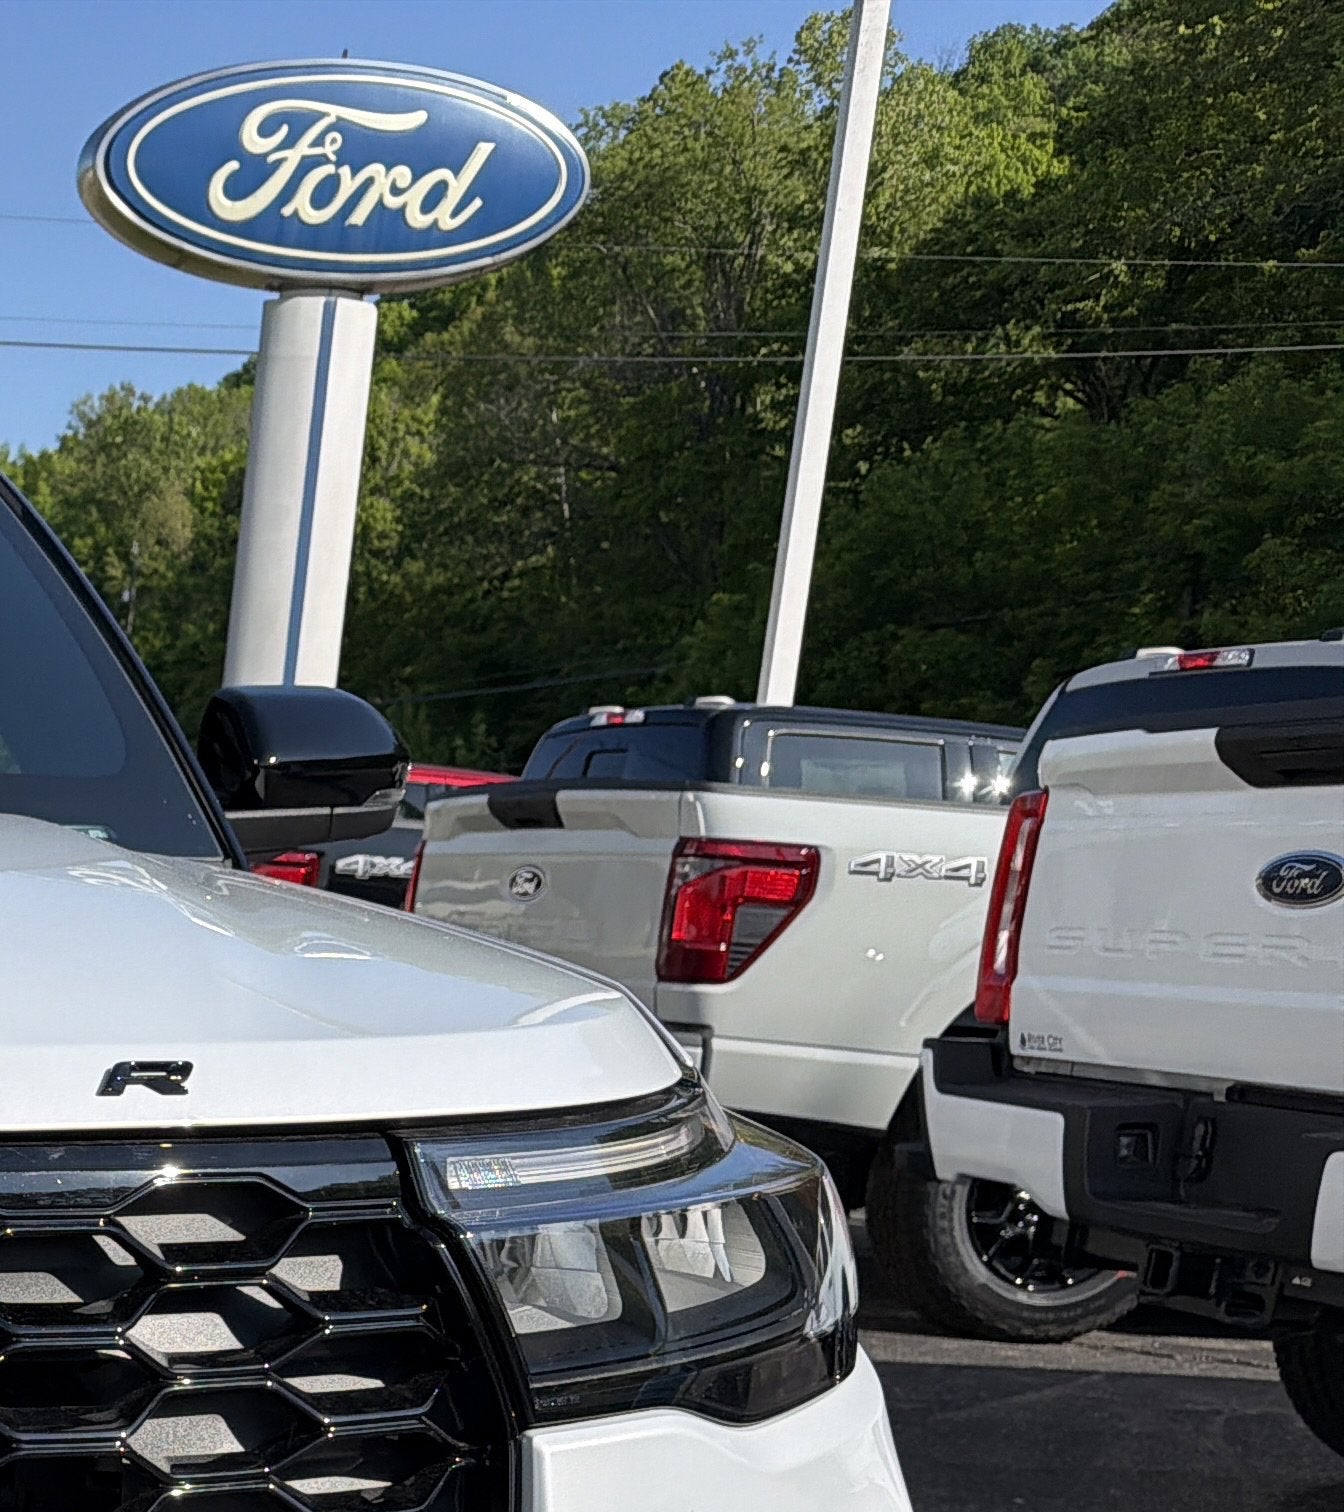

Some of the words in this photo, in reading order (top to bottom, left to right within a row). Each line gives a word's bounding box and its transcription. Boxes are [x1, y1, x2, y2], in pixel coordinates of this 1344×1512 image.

[208, 99, 496, 232] Ford
[848, 850, 988, 887] 4X4
[1272, 862, 1326, 895] Ford
